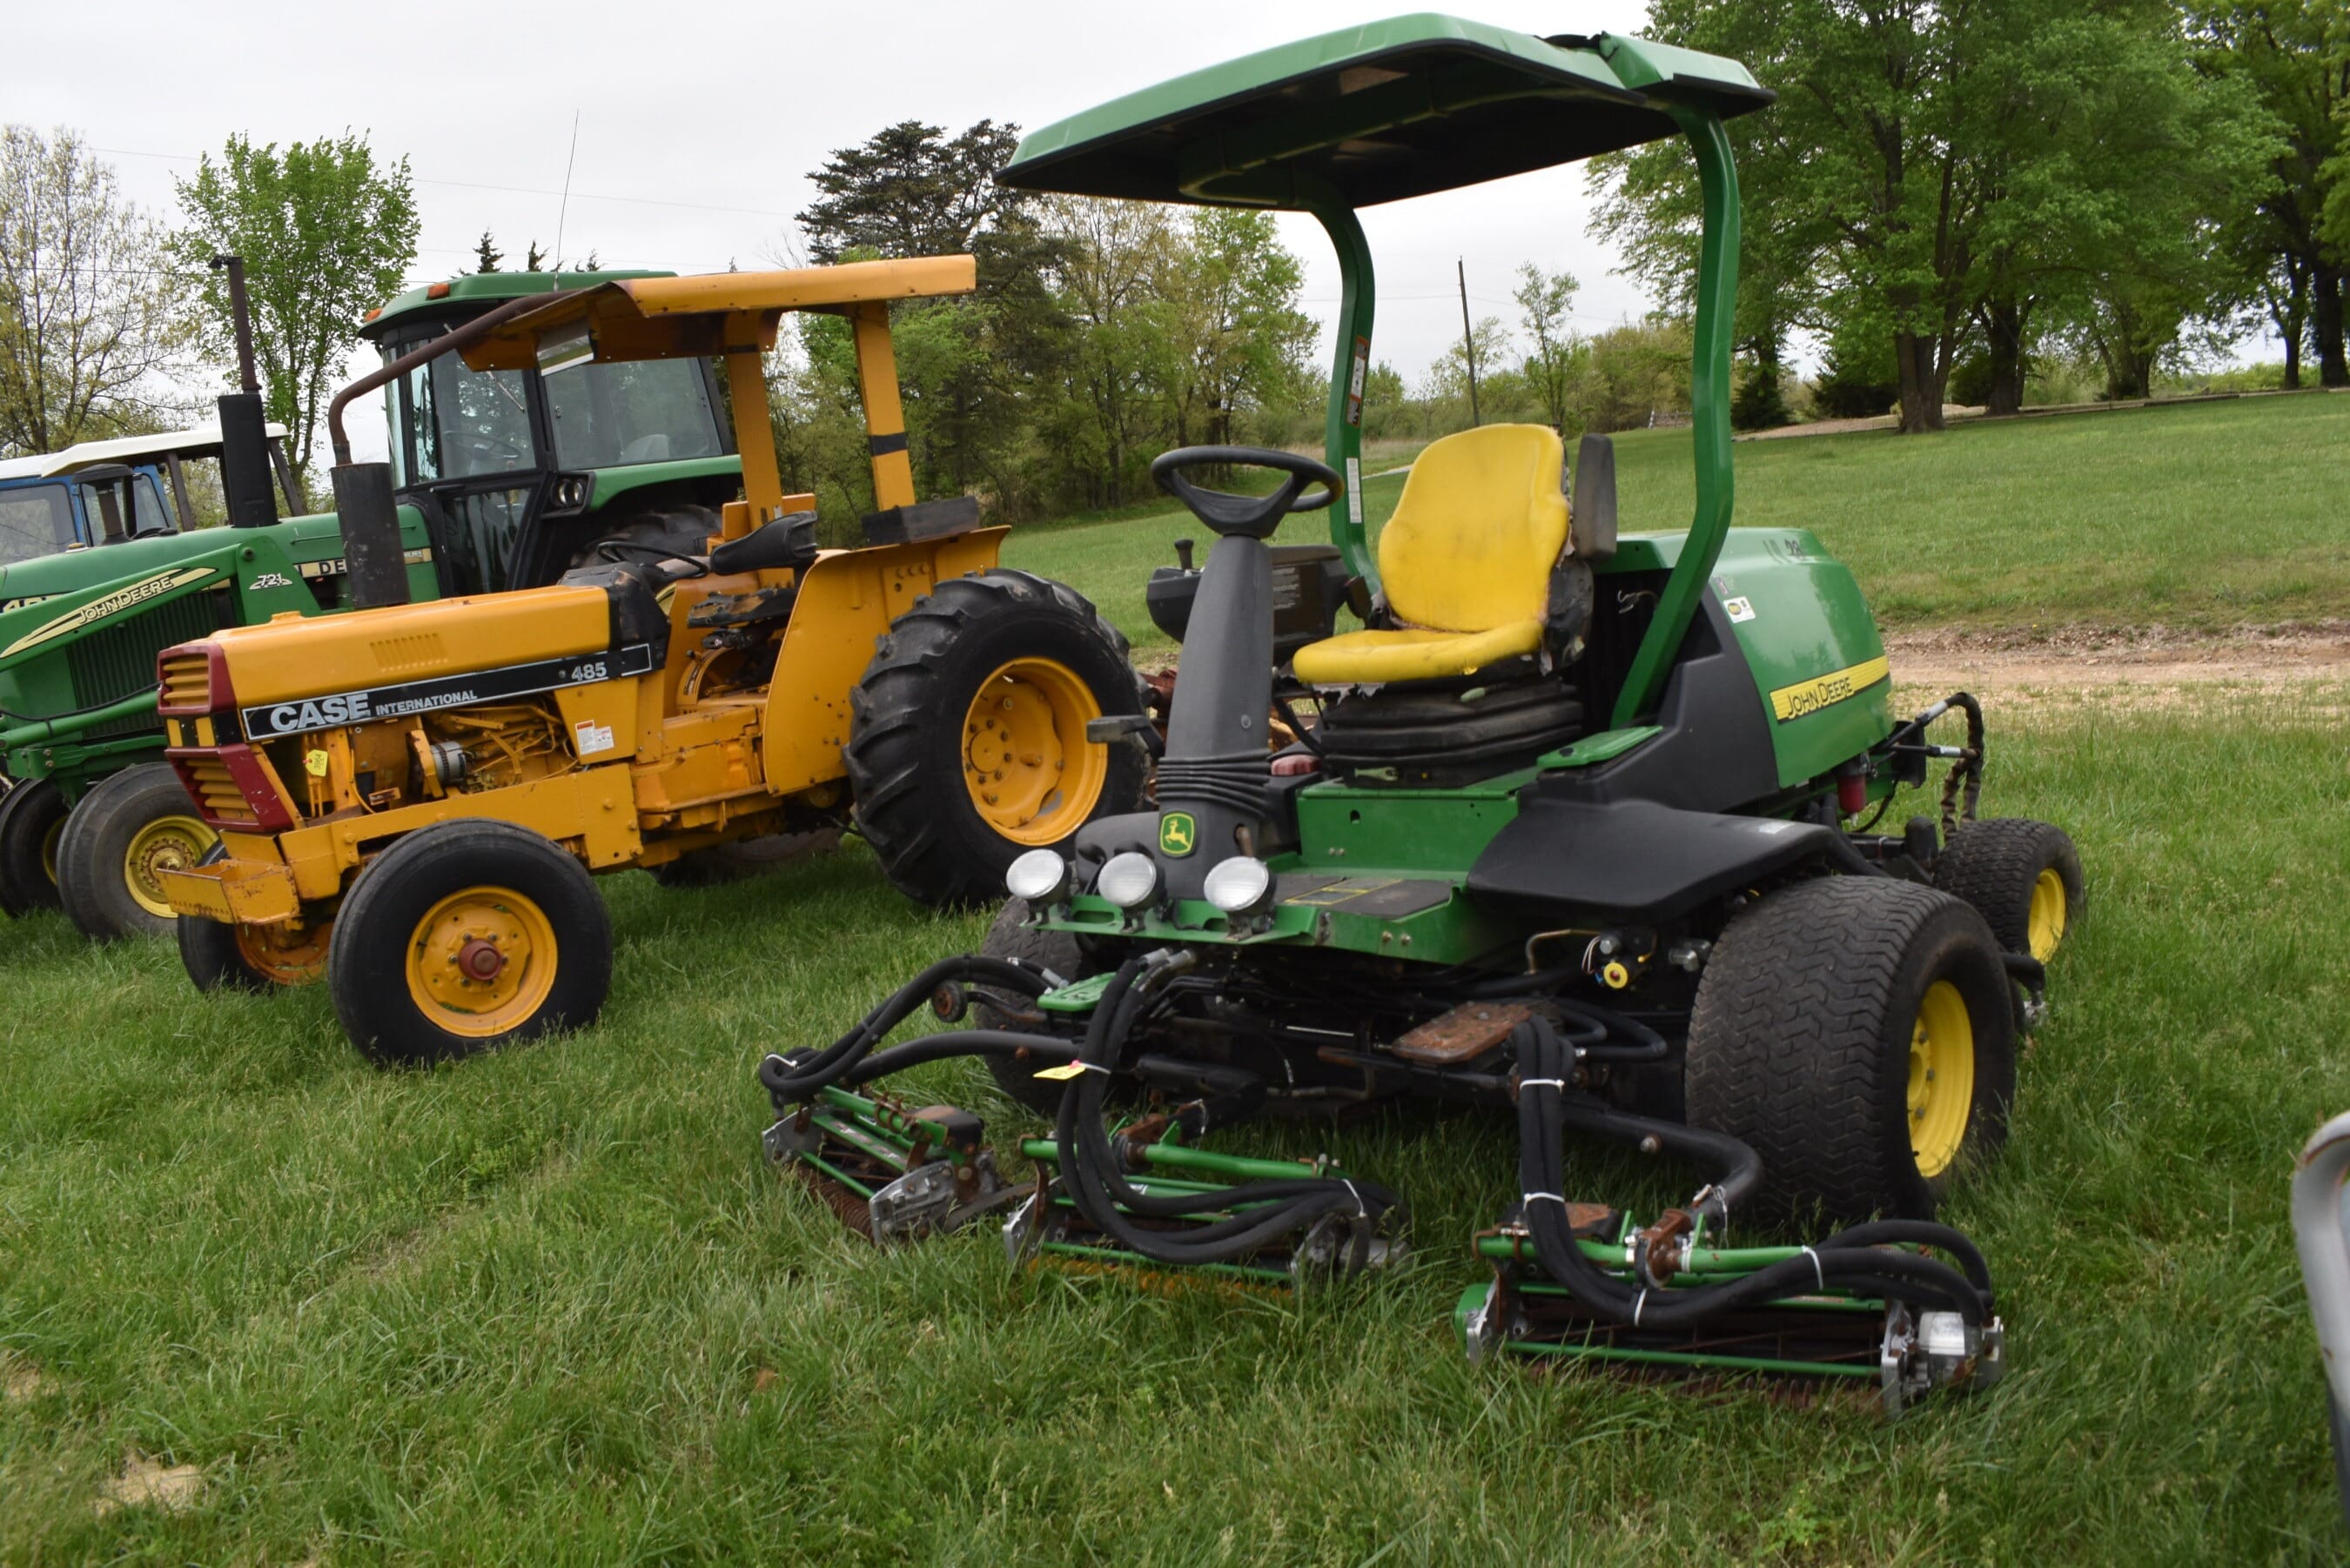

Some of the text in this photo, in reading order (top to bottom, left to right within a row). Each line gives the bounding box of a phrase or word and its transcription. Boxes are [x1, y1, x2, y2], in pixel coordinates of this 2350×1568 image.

[79, 598, 119, 623] JOHN
[118, 576, 173, 606] DEERE
[258, 573, 283, 587] 721
[571, 662, 607, 681] 485
[270, 690, 478, 732] CASE INTERNATIONAL
[1787, 676, 1853, 716] JOHN DEERE
